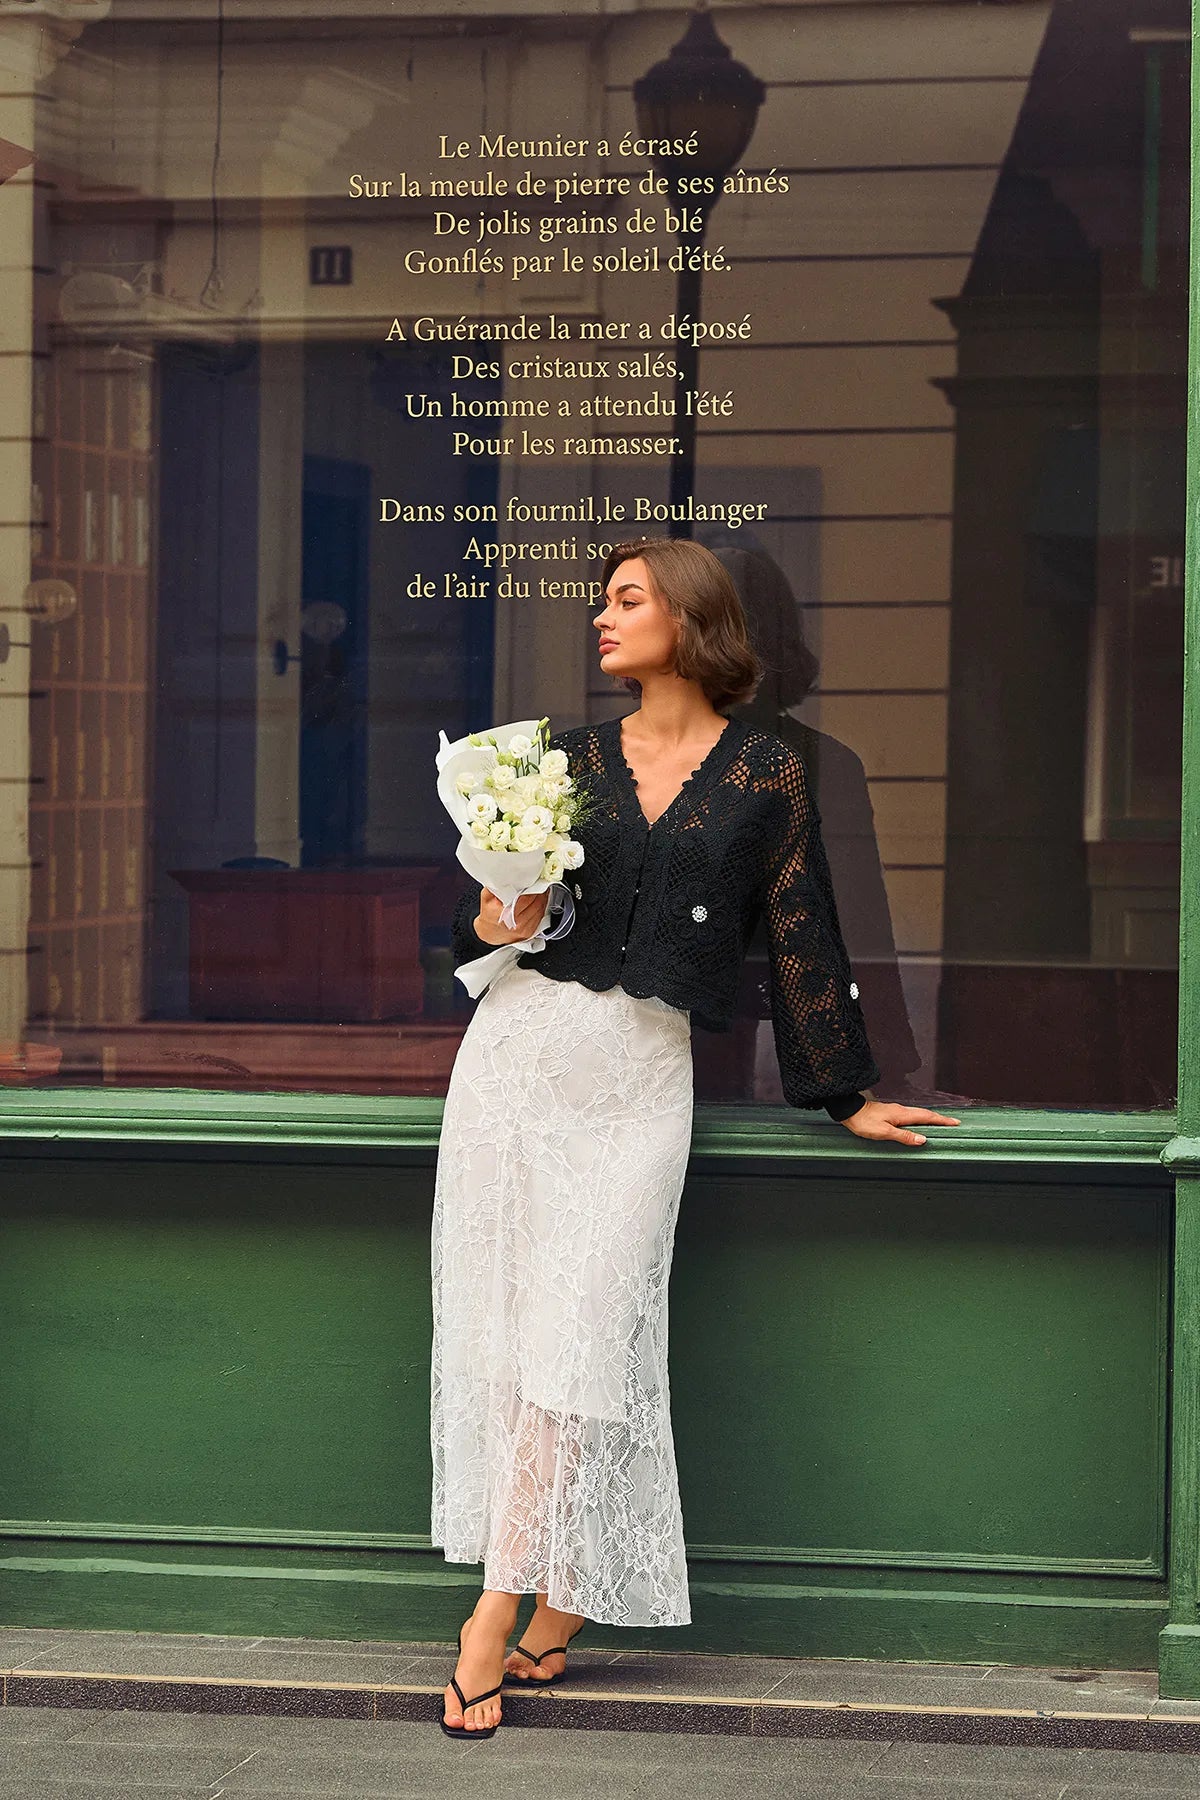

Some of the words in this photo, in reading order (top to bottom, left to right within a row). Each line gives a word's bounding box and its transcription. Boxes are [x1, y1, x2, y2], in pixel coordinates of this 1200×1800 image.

[438, 135, 470, 159] Le
[480, 133, 590, 158] Meunier
[596, 139, 611, 157] a
[618, 130, 698, 157] écrasé
[348, 174, 393, 198] Sur
[399, 172, 422, 198] la
[429, 173, 508, 197] meule
[516, 170, 546, 196] de
[553, 171, 631, 204] pierre
[638, 169, 669, 195] de
[677, 177, 715, 195] ses
[722, 167, 789, 194] aînés
[433, 212, 471, 235] De
[476, 209, 531, 243] jolis
[538, 210, 618, 243] grains
[625, 207, 656, 234] de
[663, 207, 703, 233] blé
[404, 247, 504, 274] Gonflés
[511, 255, 555, 281] par
[562, 247, 584, 273] le
[592, 246, 660, 273] soleil
[668, 245, 732, 273] d’été.
[386, 318, 407, 341] A
[414, 314, 541, 342] Guérande
[548, 314, 572, 340] la
[579, 322, 631, 340] mer
[638, 322, 653, 340] a
[660, 313, 752, 347] déposé
[451, 355, 500, 379] Des
[508, 354, 611, 379] cristaux
[617, 352, 685, 381] salés,
[406, 394, 444, 418] Un
[450, 392, 550, 417] homme
[557, 400, 572, 417] a
[579, 390, 678, 417] attendu
[685, 390, 734, 417] l’été
[452, 432, 515, 456] Pour
[521, 430, 555, 456] les
[563, 437, 684, 455] ramasser.
[379, 498, 445, 522] Dans
[453, 505, 498, 522] son
[633, 495, 768, 529] Boulanger
[462, 536, 578, 568] Apprenti
[406, 573, 436, 599] de
[443, 572, 490, 599] l’air
[497, 573, 531, 599] du
[538, 577, 603, 606] temp
